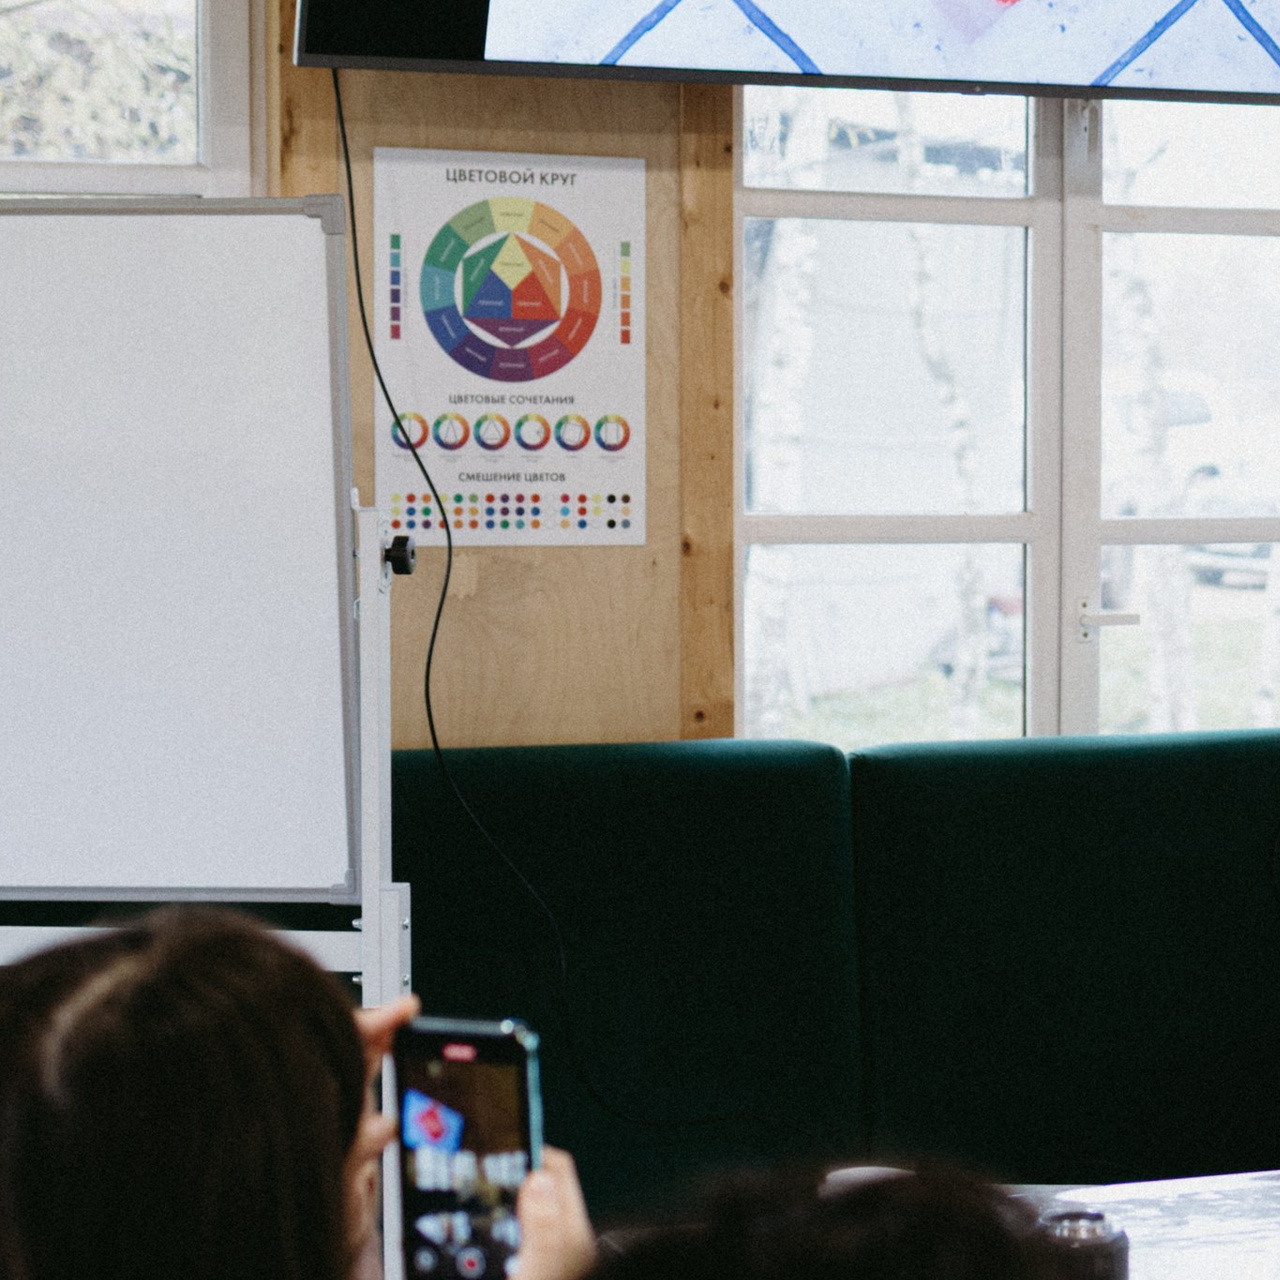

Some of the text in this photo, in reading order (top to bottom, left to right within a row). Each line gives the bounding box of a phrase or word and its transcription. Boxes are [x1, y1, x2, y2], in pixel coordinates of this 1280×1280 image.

[446, 168, 577, 186] ЦВЕТОВОЙ КРУГ
[448, 394, 575, 405] ЦВЕТОВЫЕ СОЧЕТАНИЯ
[458, 472, 566, 484] СМЕШЕНИЕ ЦВЕТОВ
